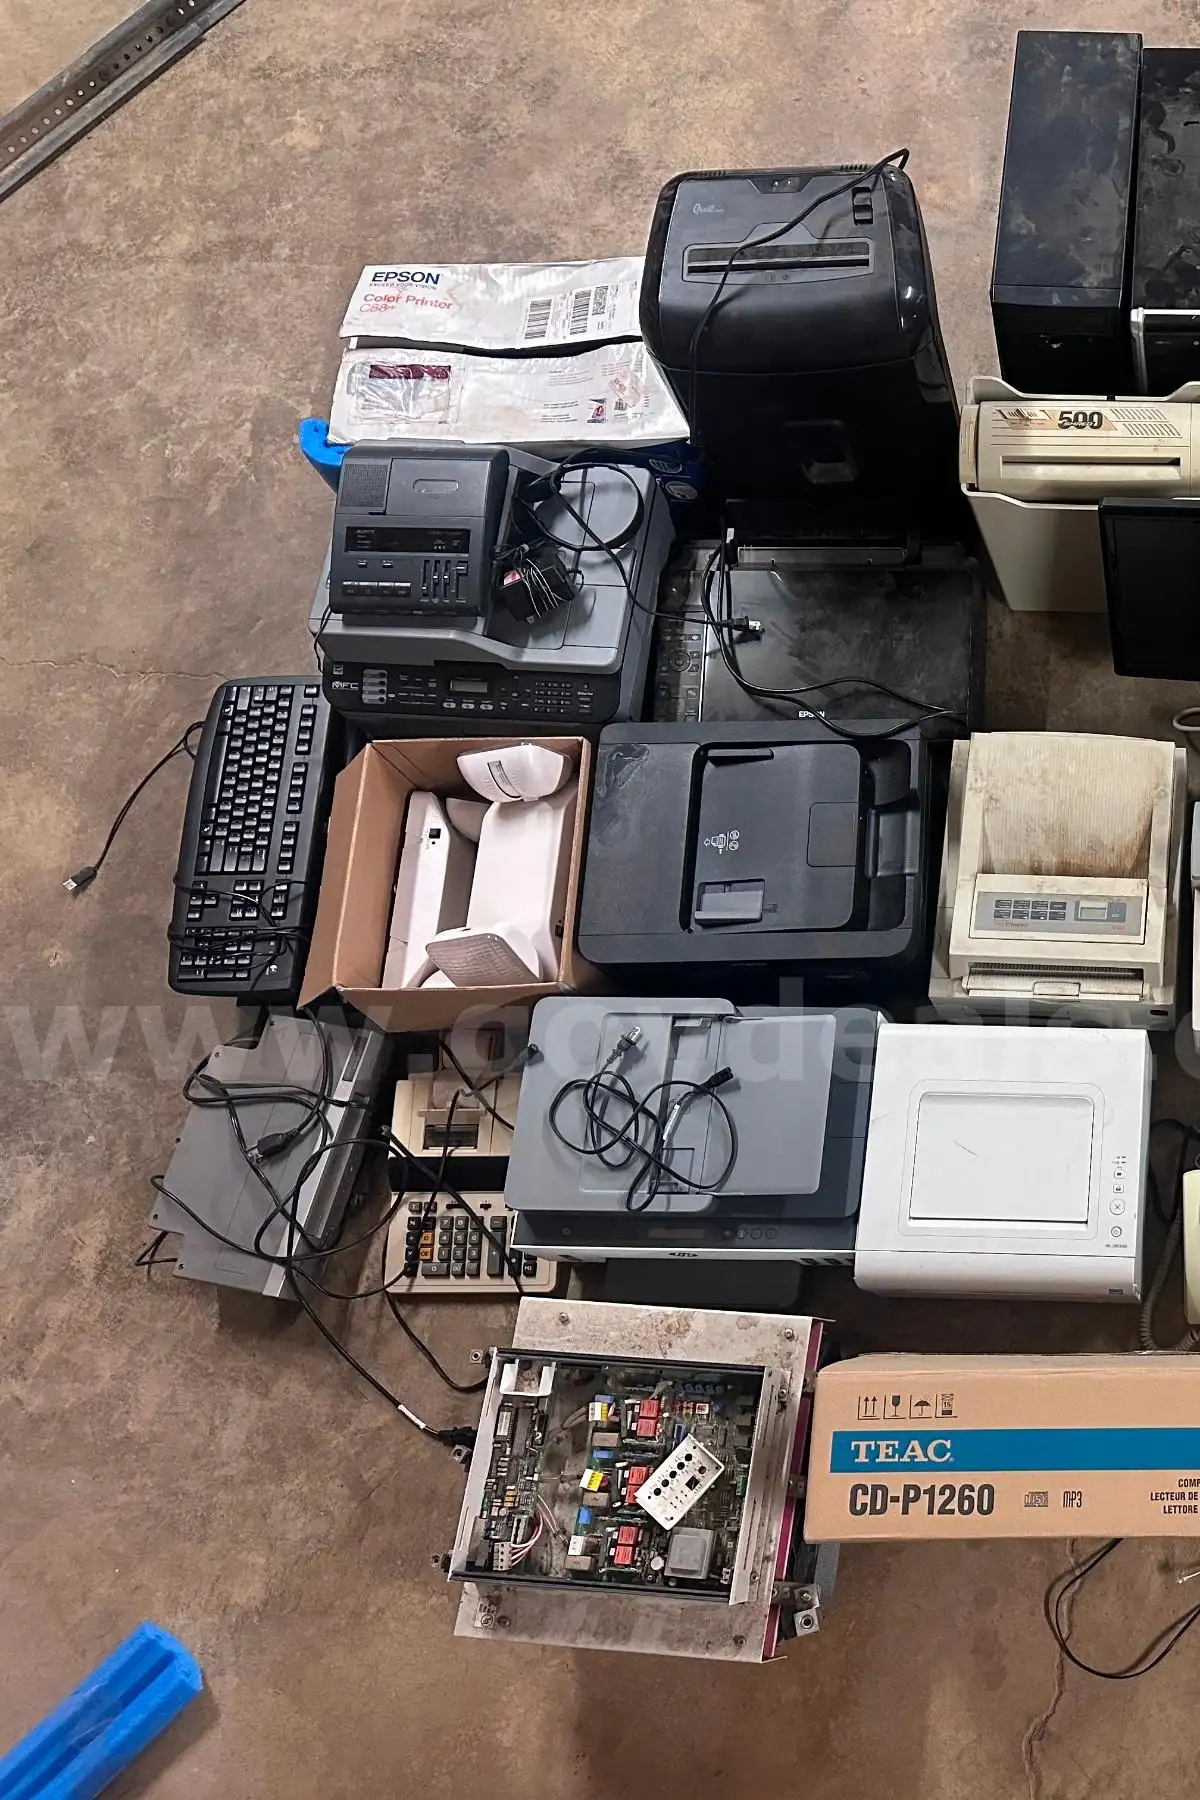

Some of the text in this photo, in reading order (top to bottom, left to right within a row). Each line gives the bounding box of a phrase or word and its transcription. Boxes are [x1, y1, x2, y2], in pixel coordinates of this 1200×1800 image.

[371, 271, 441, 285] EPSON
[359, 303, 397, 312] C88+
[363, 293, 454, 309] Color Printer
[1057, 410, 1103, 430] 500
[798, 710, 825, 718] EPSN
[850, 1439, 953, 1463] TEAC
[849, 1483, 996, 1516] CD-P1260
[1150, 1491, 1186, 1501] LECTEUR
[1187, 1491, 1199, 1501] DE
[1163, 1504, 1199, 1514] LETTORE
